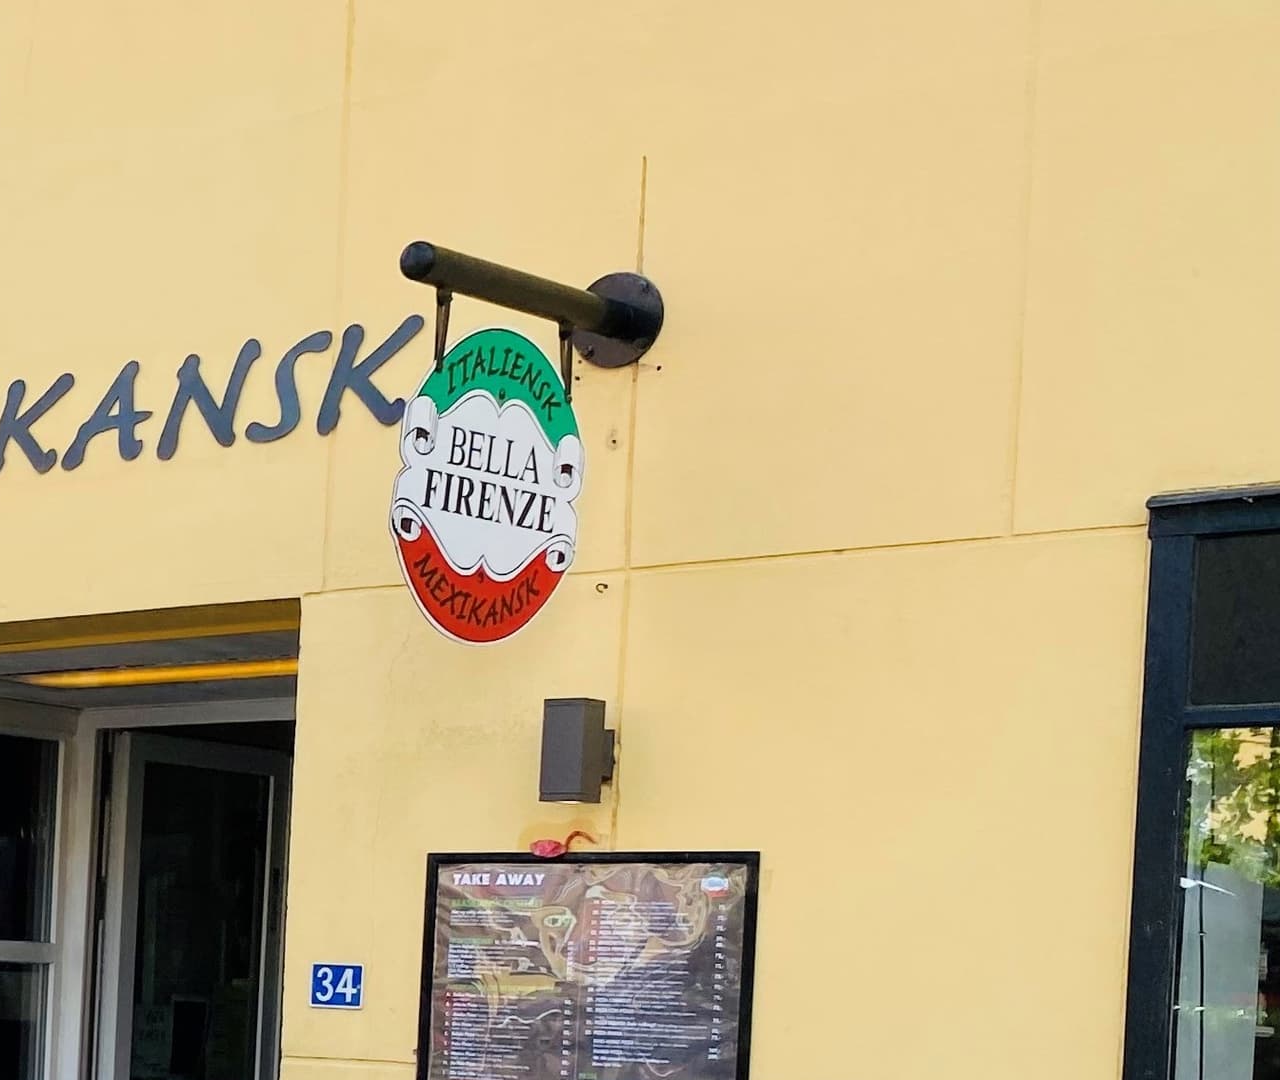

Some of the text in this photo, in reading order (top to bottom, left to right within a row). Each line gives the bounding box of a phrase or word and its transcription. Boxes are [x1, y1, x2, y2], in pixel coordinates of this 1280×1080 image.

[446, 346, 562, 422] ITALIENSK
[446, 425, 541, 484] BELLA
[421, 467, 557, 534] FIRENZE
[414, 552, 541, 628] MEXIKANSK
[453, 873, 545, 886] TAKE AWAY
[315, 967, 357, 1003] 34
